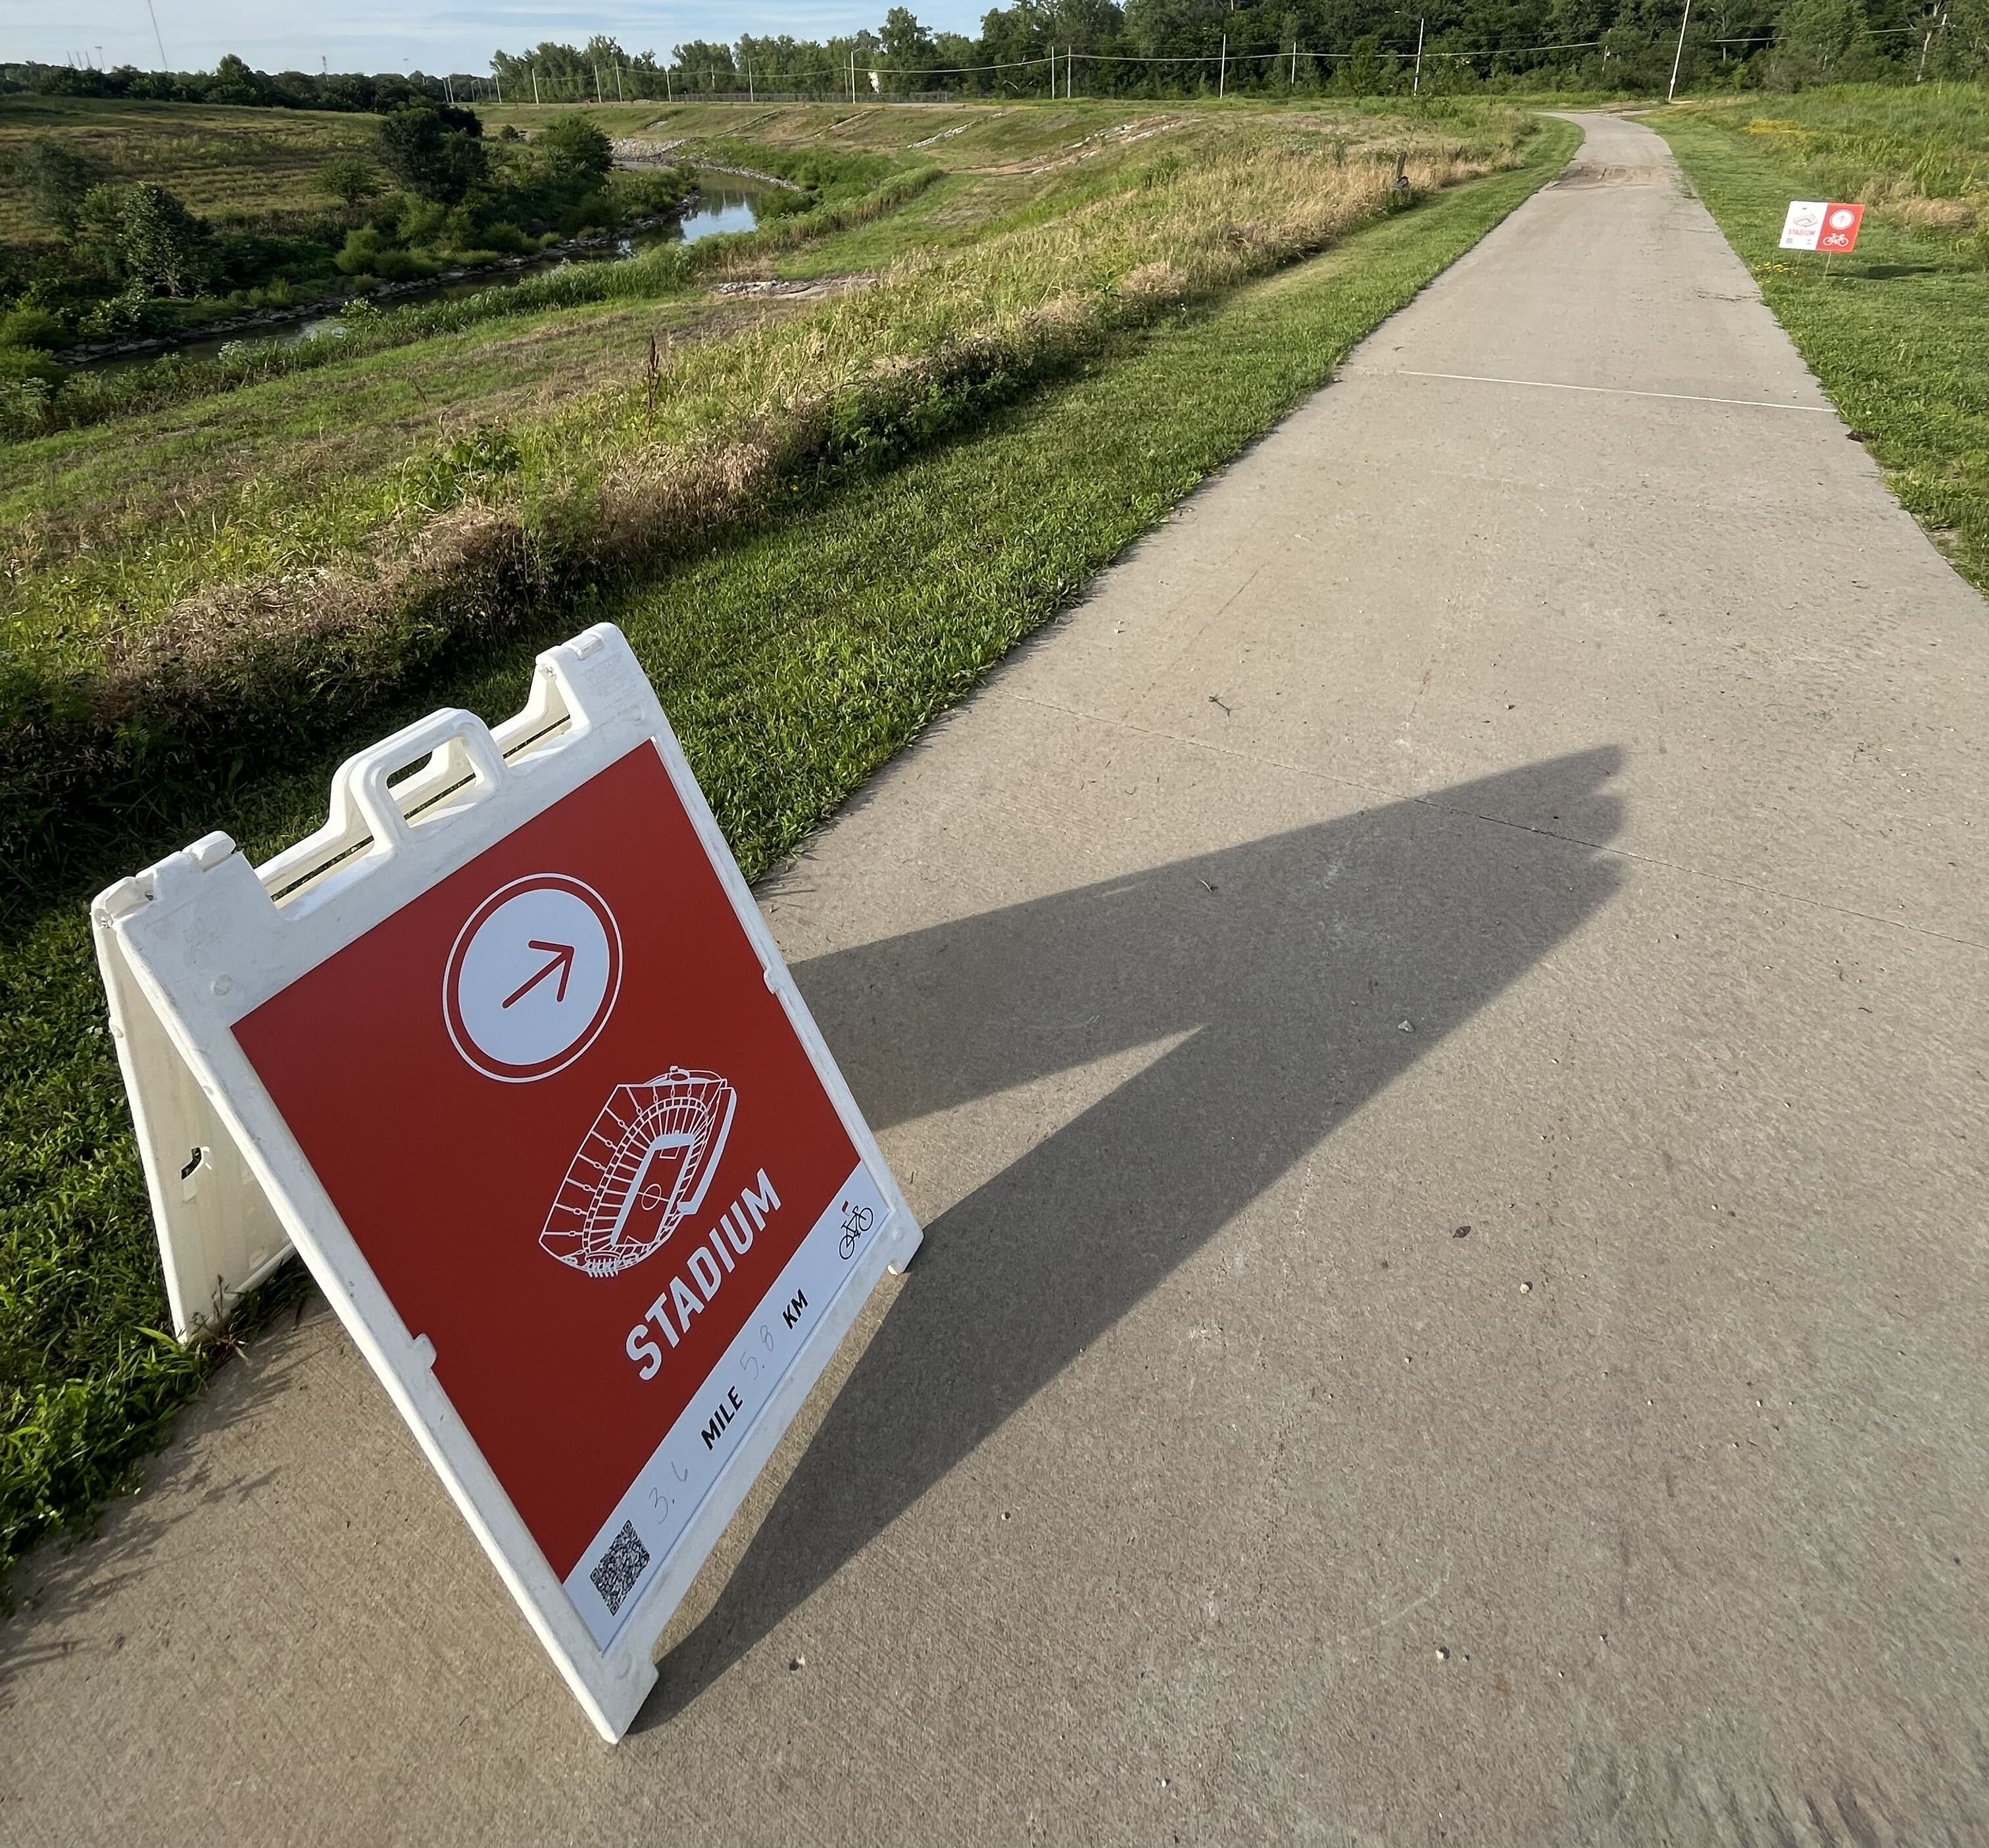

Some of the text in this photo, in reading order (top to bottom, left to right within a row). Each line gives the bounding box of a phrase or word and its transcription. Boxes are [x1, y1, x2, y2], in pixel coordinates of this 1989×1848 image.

[626, 1168, 781, 1380] STADIUM
[700, 1385, 743, 1451] MILE
[739, 1325, 774, 1380] 5.8
[782, 1288, 809, 1330] KM
